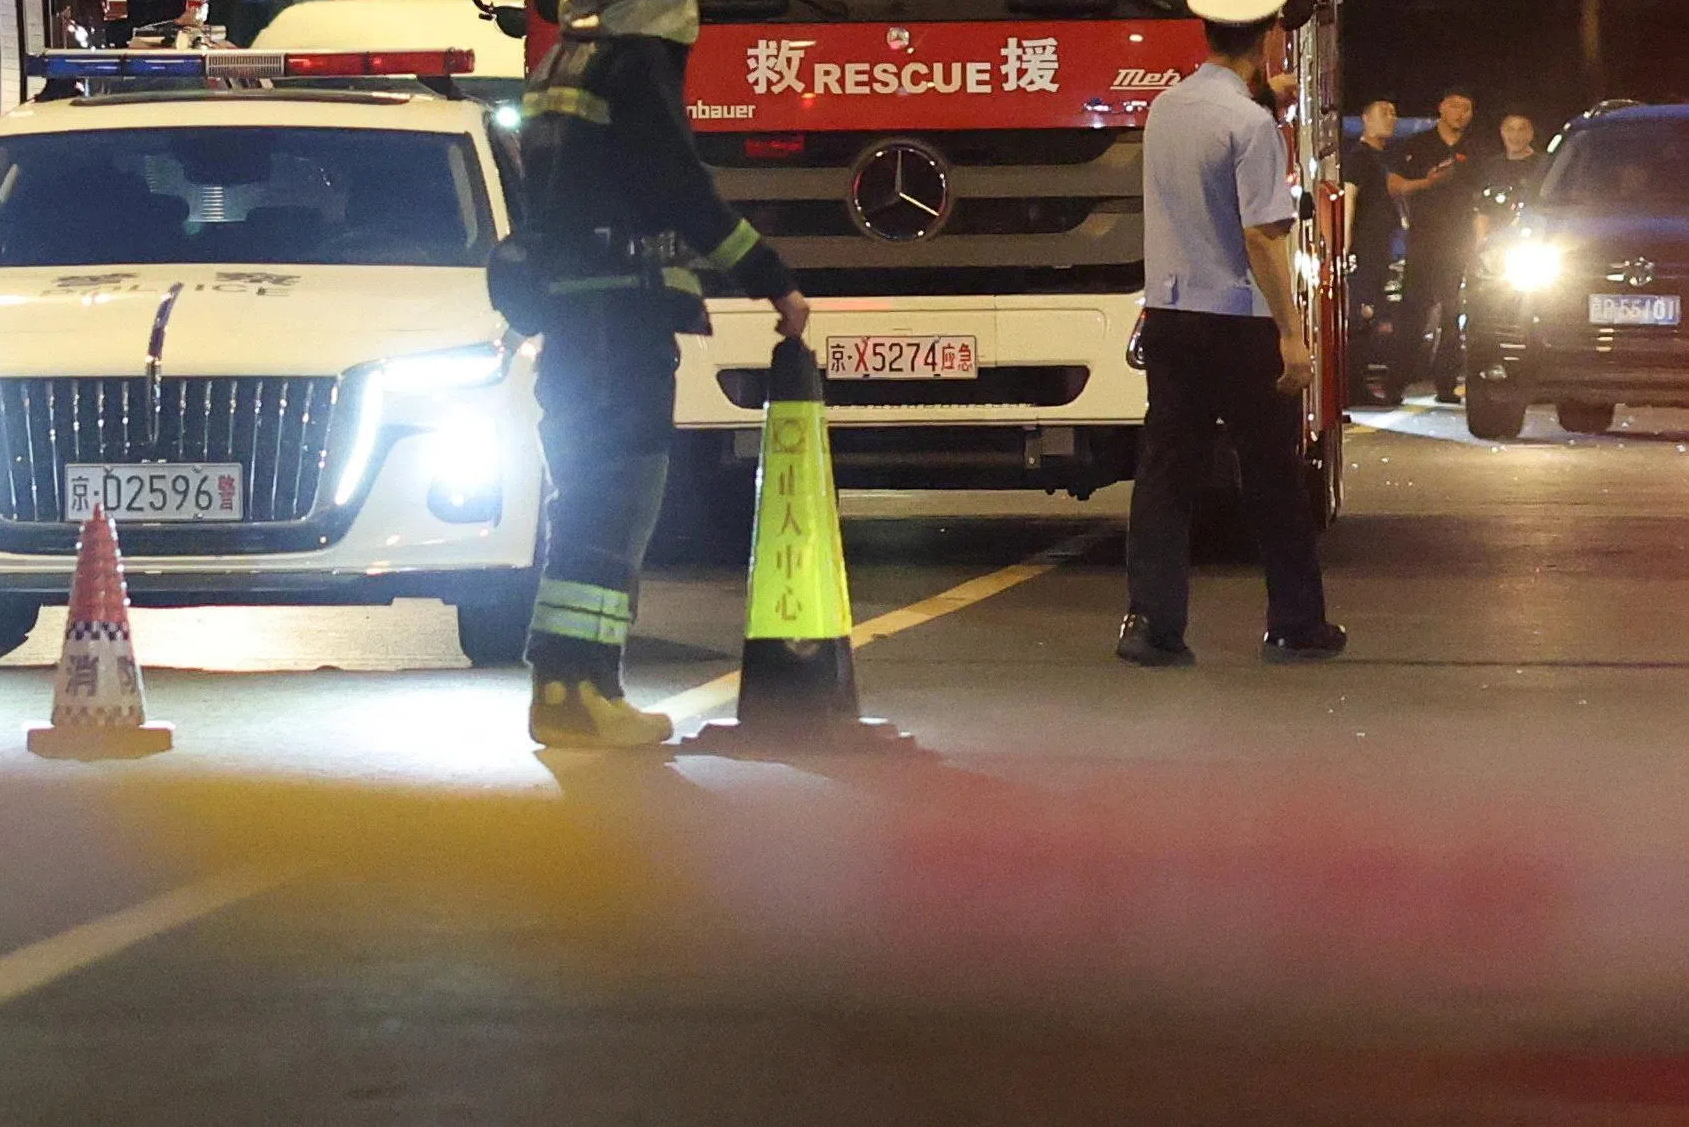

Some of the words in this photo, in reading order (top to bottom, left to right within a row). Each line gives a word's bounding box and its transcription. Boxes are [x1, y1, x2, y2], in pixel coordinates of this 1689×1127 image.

[746, 39, 806, 94] 救
[813, 62, 992, 94] RESCUE
[1000, 37, 1060, 92] 援
